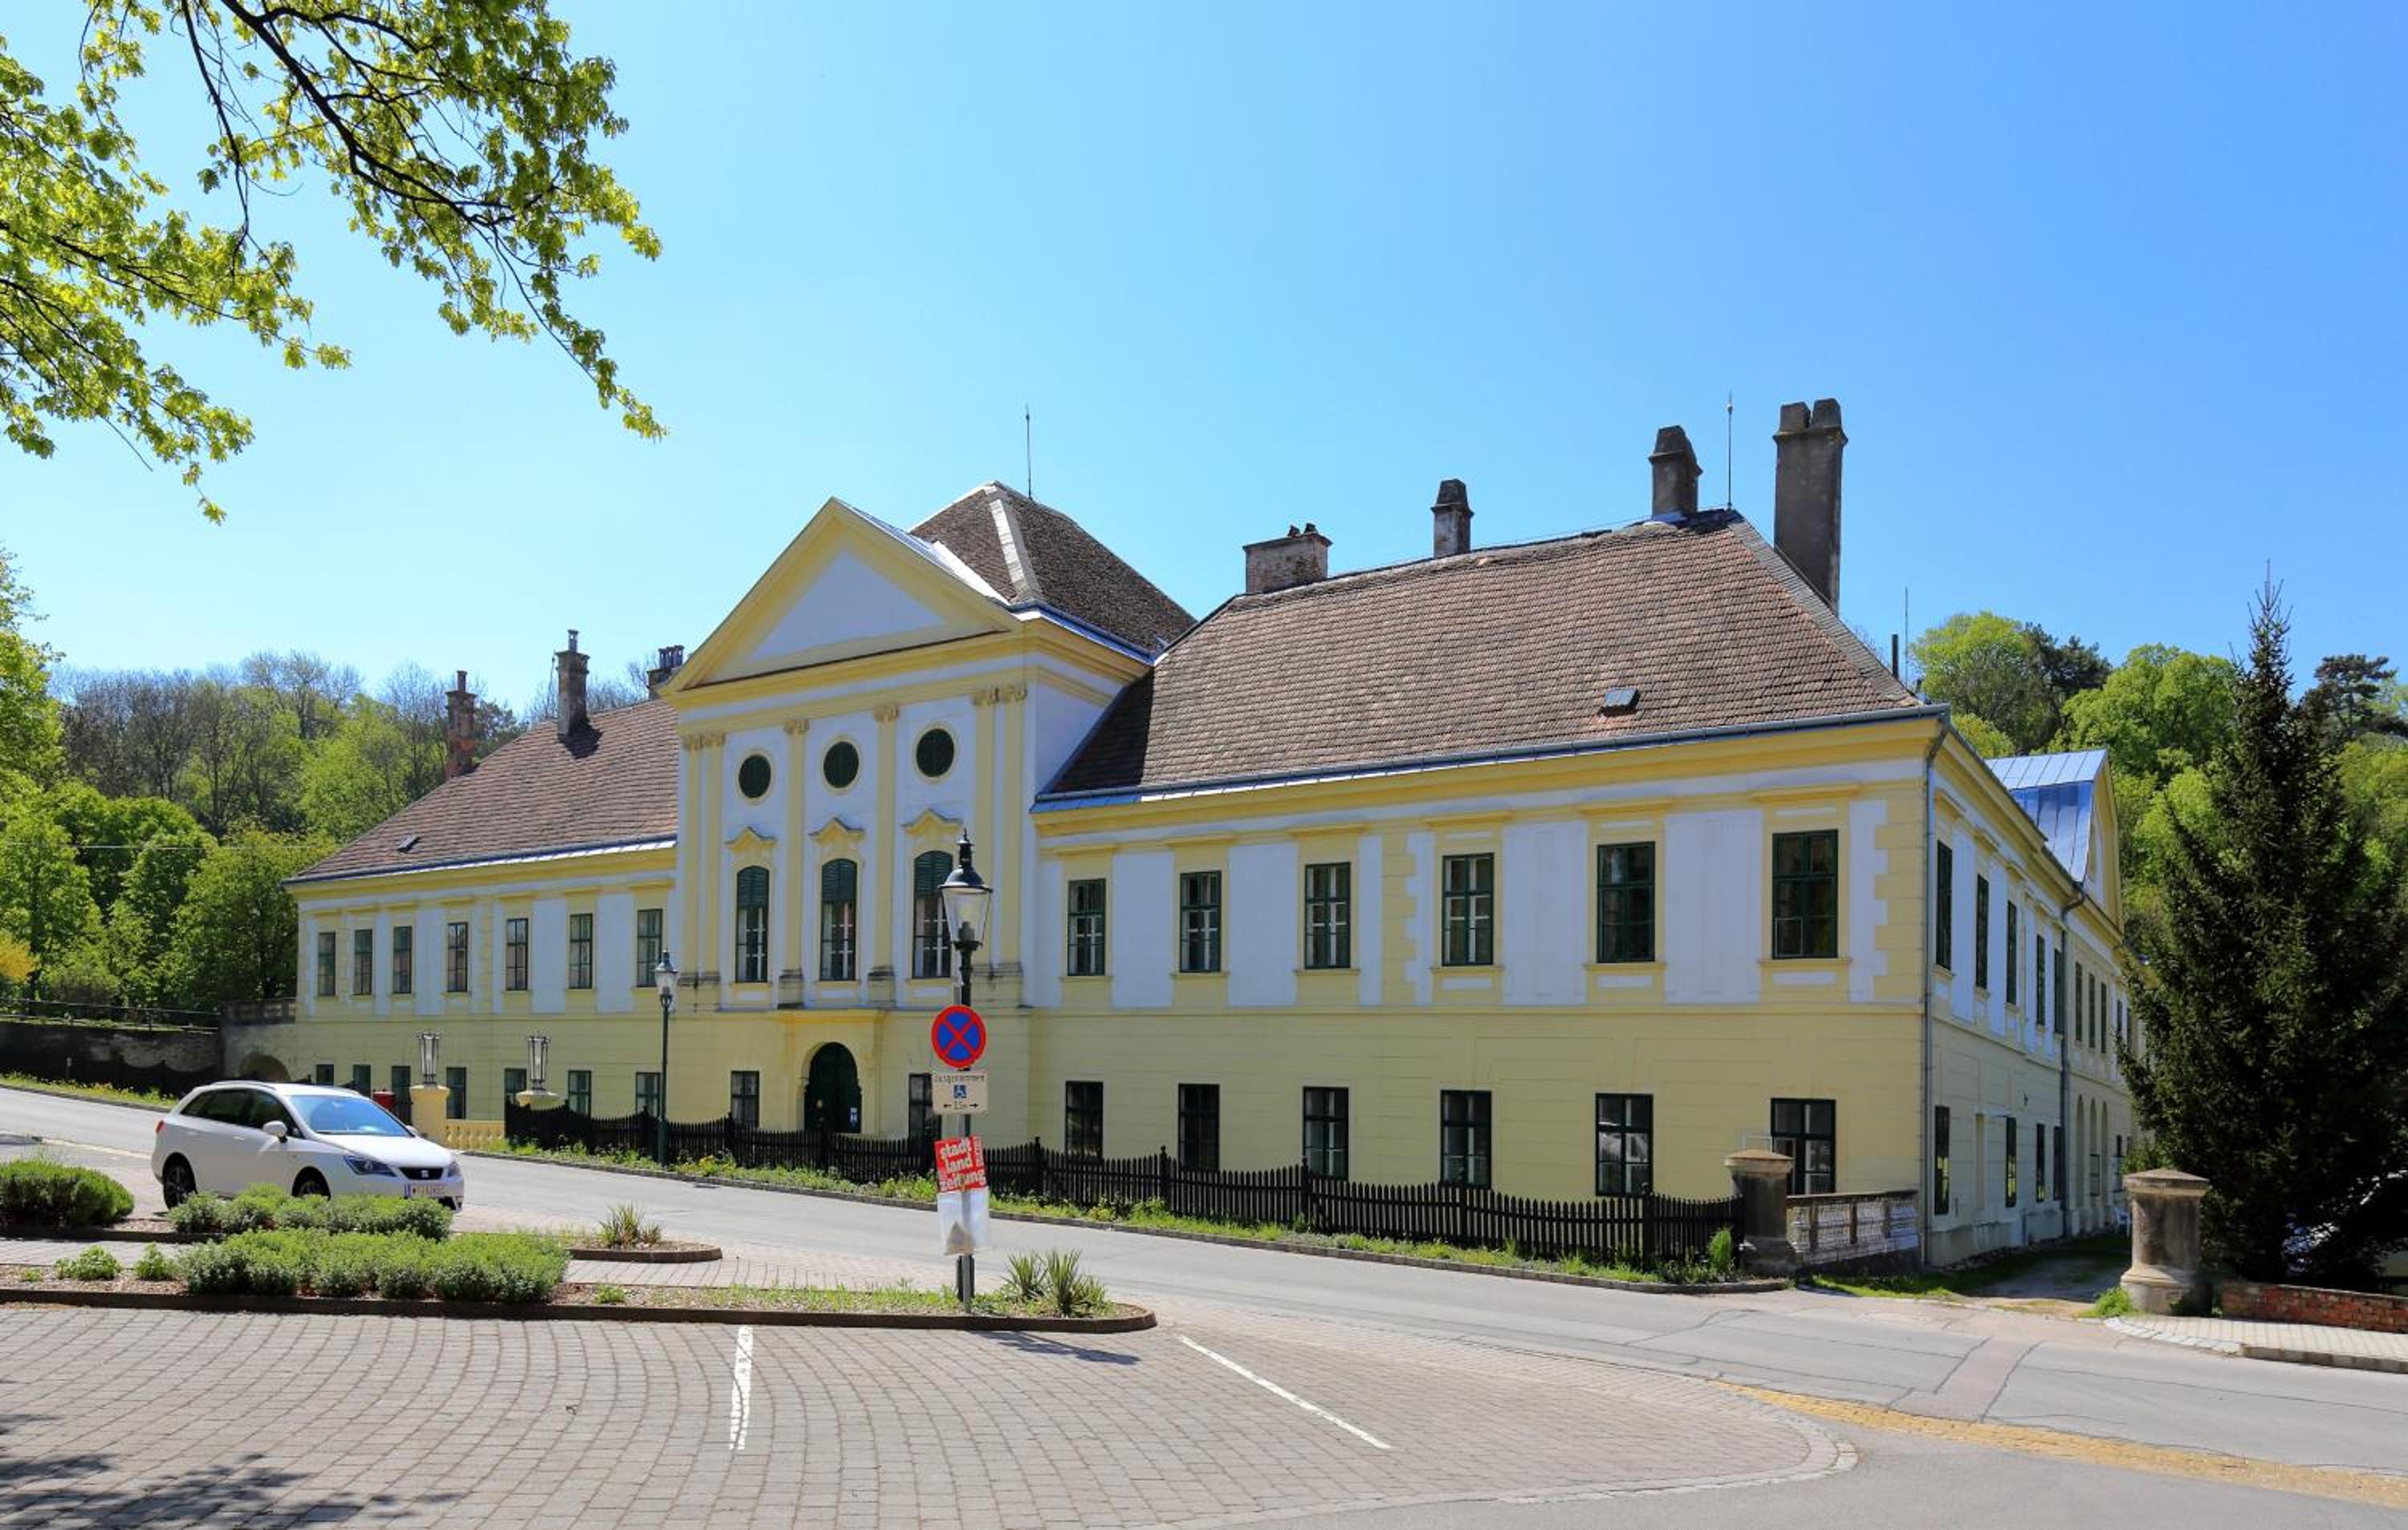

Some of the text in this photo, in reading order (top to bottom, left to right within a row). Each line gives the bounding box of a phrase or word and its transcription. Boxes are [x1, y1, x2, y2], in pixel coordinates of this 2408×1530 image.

[940, 1137, 972, 1160] stadt
[945, 1152, 973, 1174] land
[939, 1169, 987, 1191] zeitung
